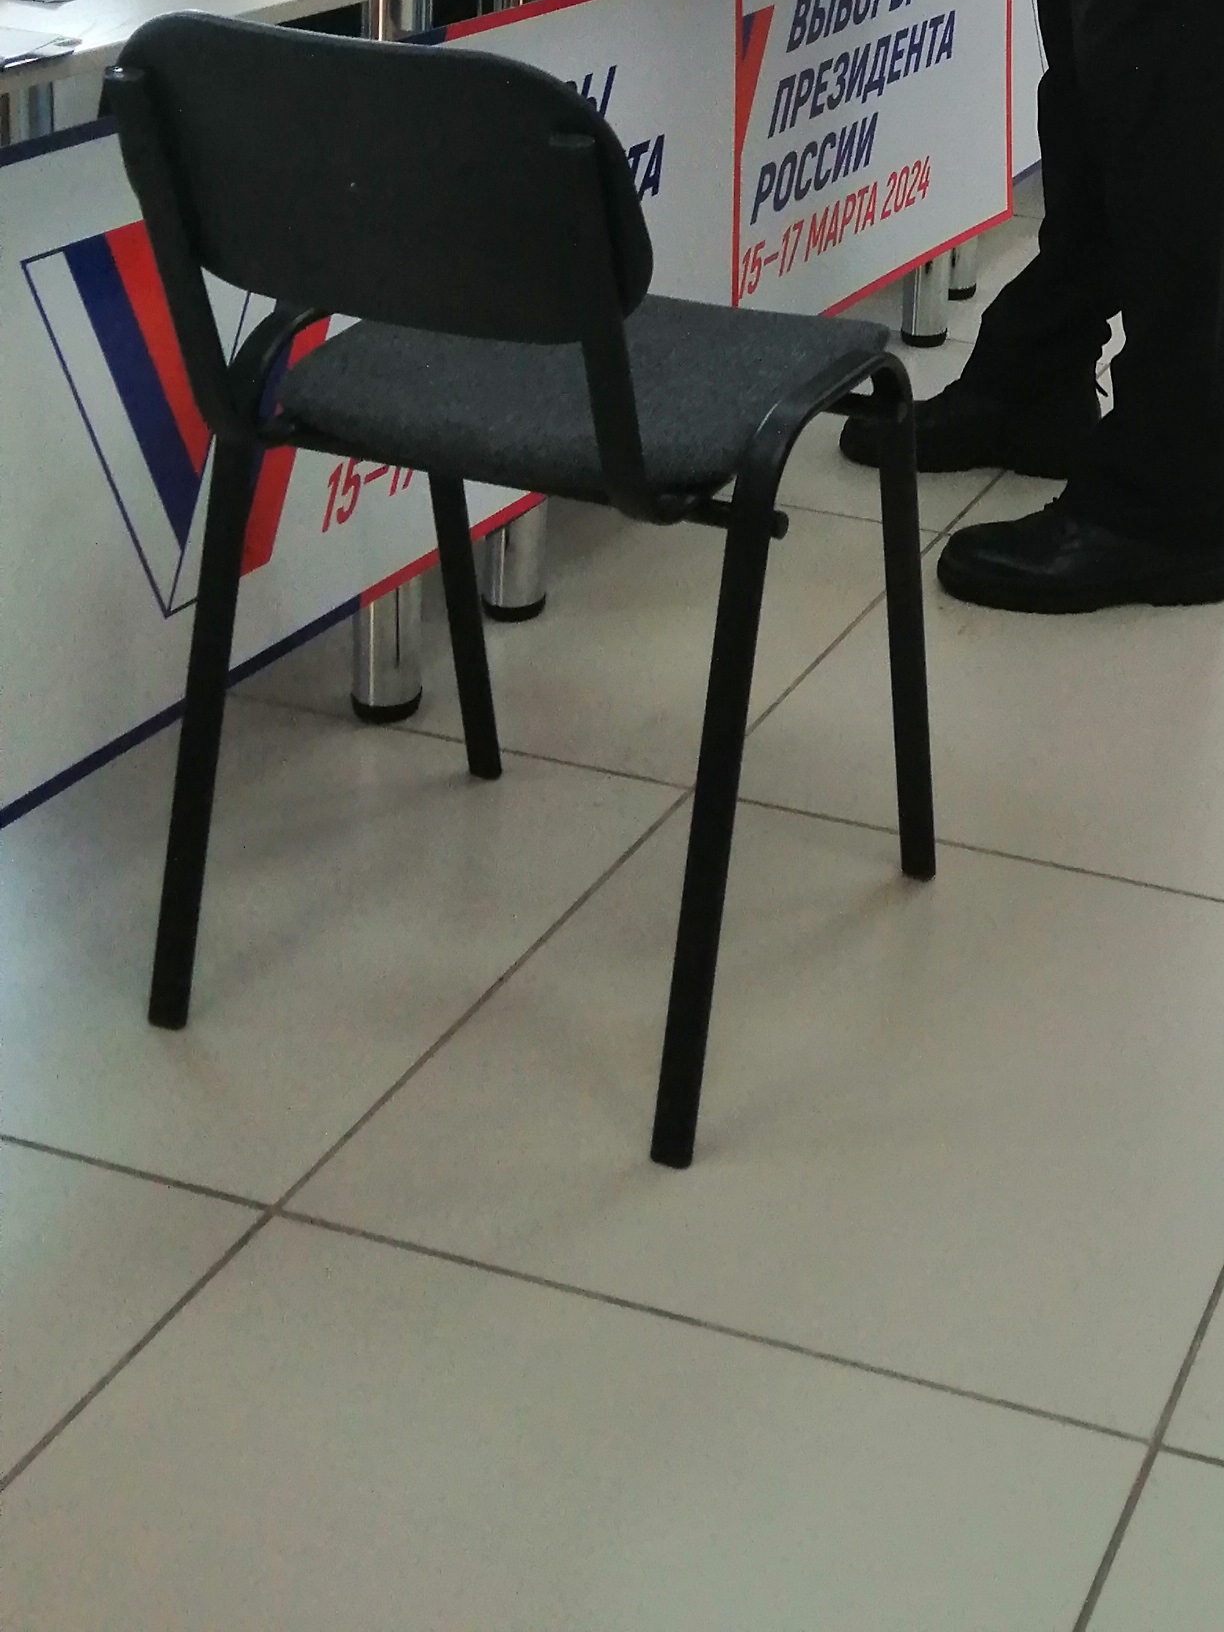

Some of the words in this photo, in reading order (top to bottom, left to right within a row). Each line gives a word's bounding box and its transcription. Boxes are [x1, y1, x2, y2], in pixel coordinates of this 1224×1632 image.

[767, 9, 957, 139] ПРЕЗИДЕНТА
[750, 111, 879, 226] РОССИИ
[804, 181, 878, 263] МАРТА
[880, 155, 931, 222] 2024
